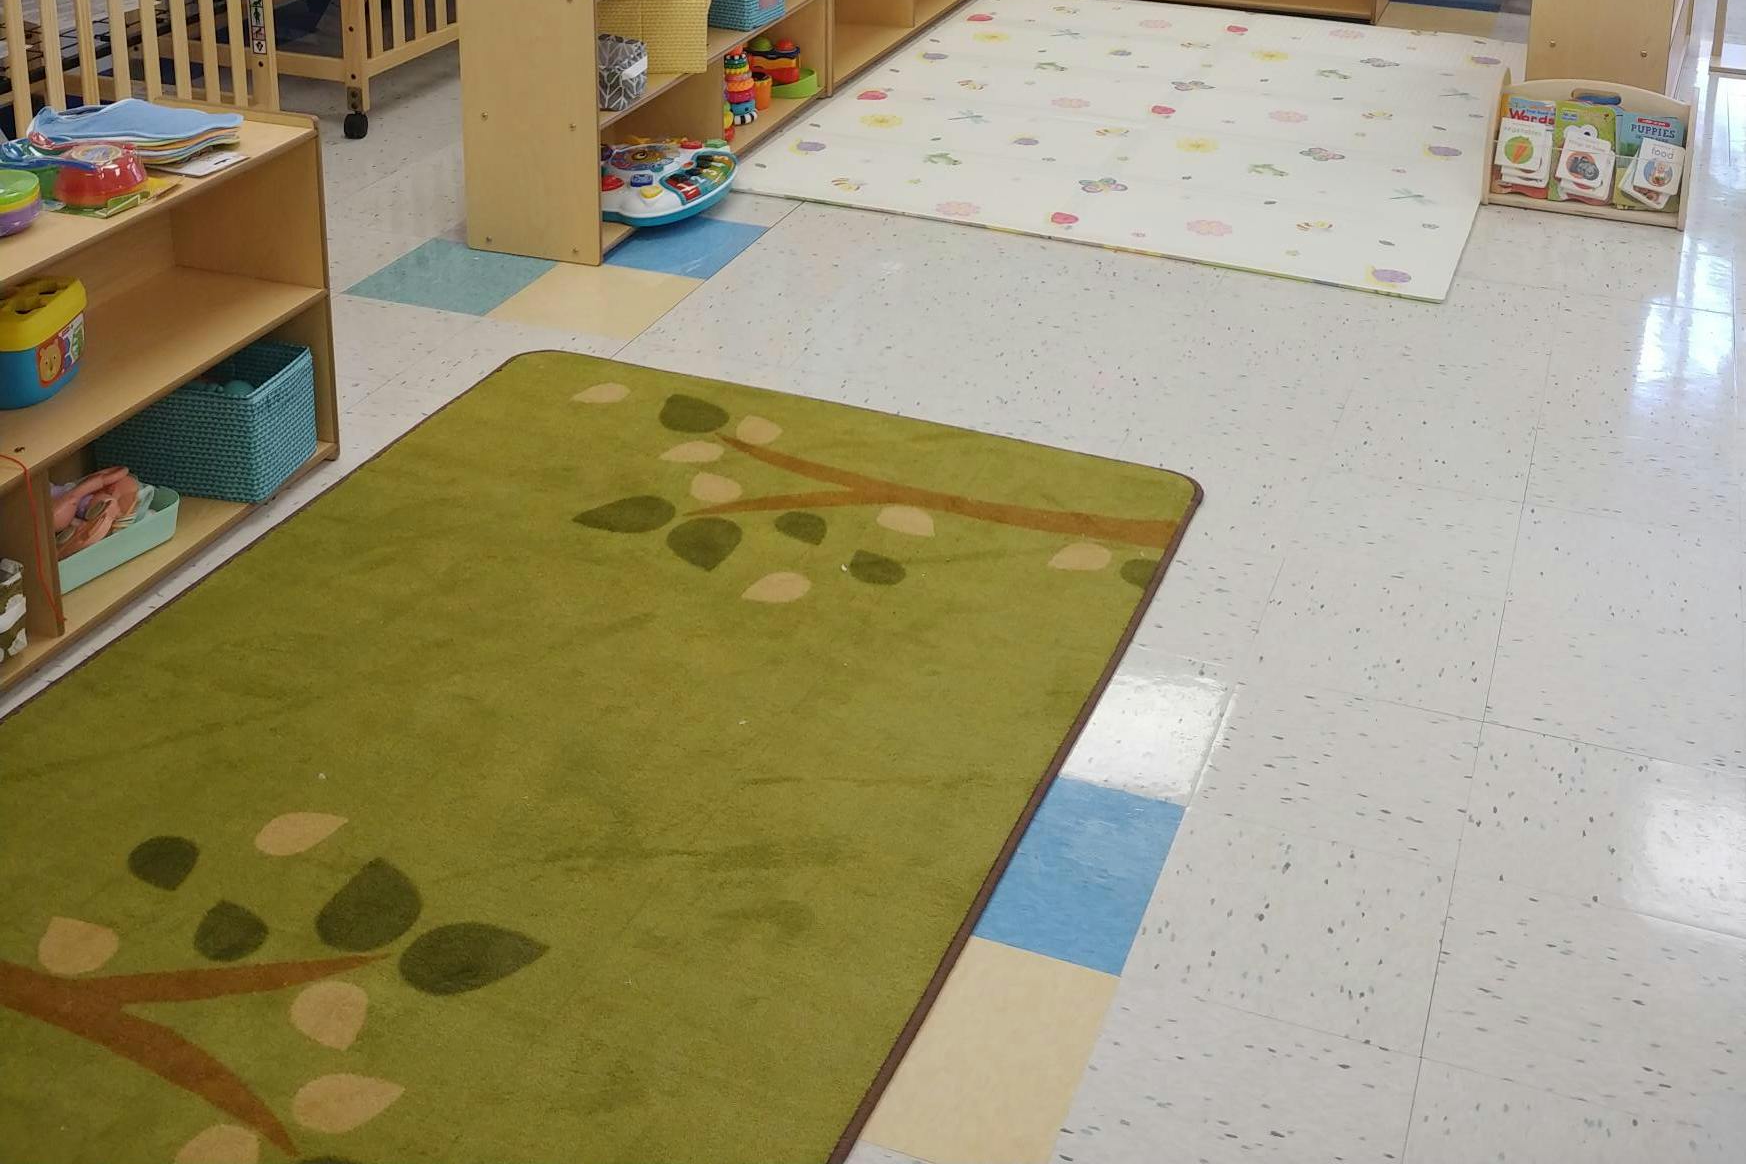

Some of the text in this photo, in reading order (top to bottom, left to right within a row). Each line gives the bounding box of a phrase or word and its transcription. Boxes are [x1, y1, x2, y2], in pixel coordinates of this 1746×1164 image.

[1509, 107, 1555, 125] Words
[1631, 124, 1676, 138] PUPPIES
[1651, 146, 1674, 160] food
